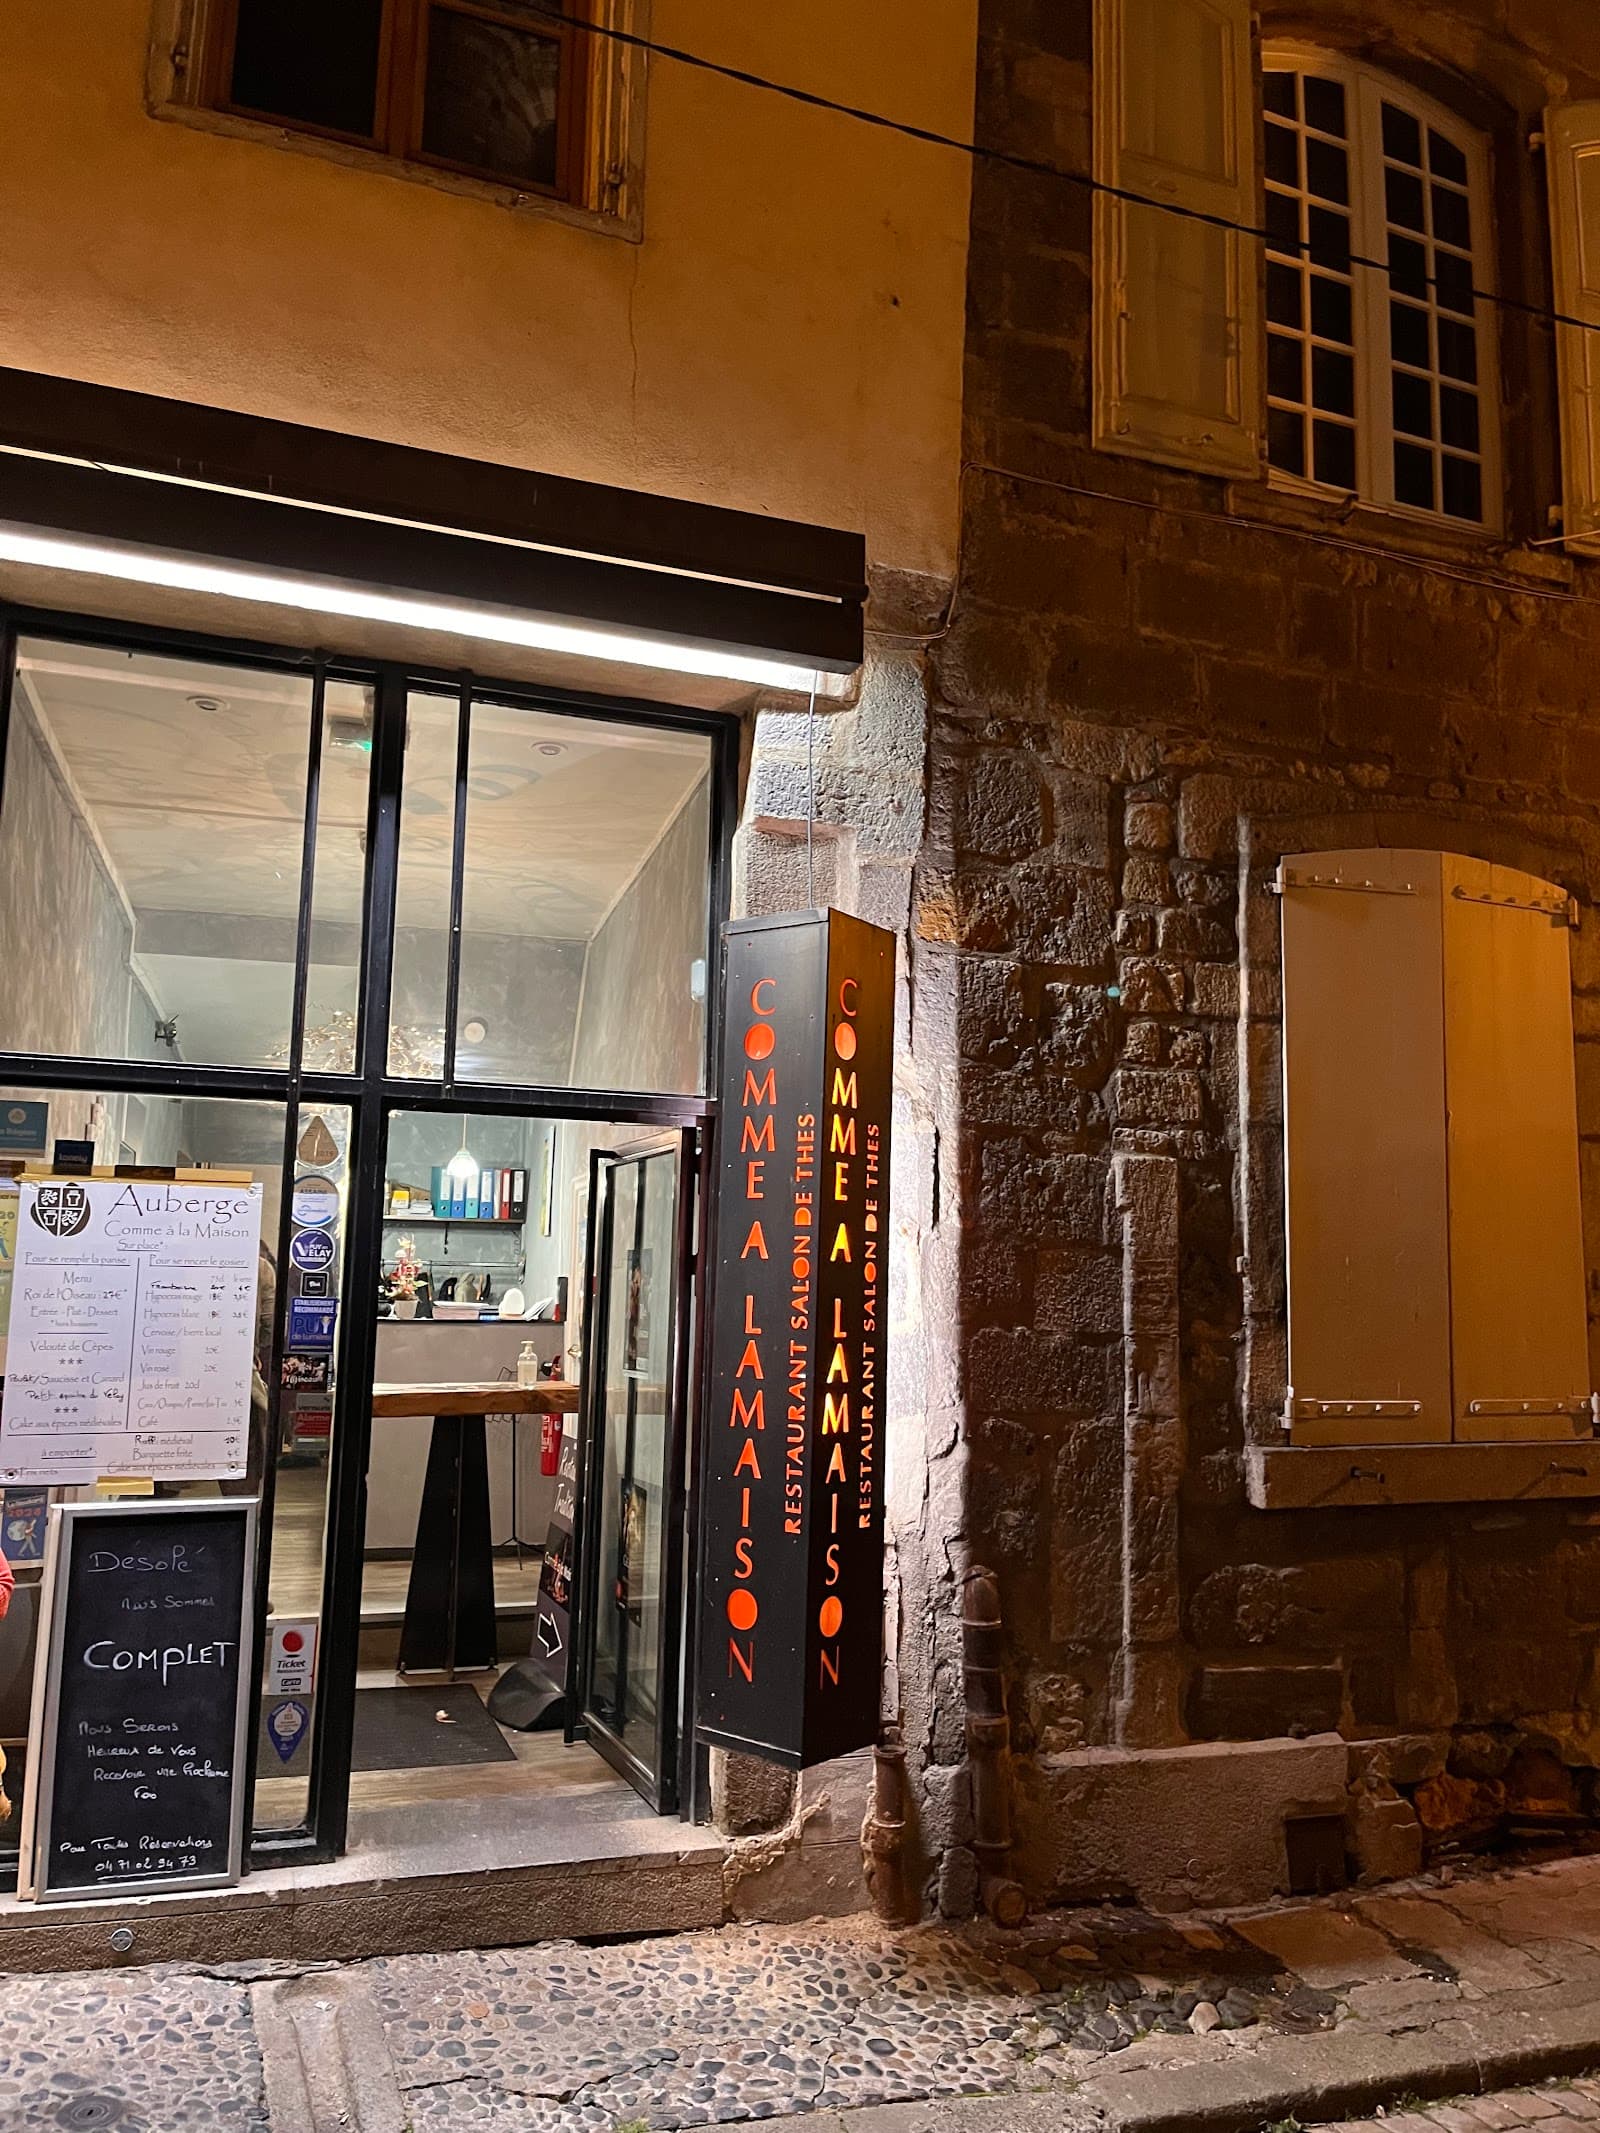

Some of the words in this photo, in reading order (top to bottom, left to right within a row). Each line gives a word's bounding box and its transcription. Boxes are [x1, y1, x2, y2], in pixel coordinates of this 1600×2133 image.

[740, 978, 778, 1199] COMME
[829, 978, 858, 1202] COMME
[795, 1113, 816, 1189] THES
[866, 1124, 880, 1190] THES
[108, 1184, 249, 1224] Auberge
[794, 1191, 814, 1226] DE
[865, 1199, 878, 1232] DE
[104, 1220, 162, 1237] Comme
[166, 1224, 175, 1236] à
[178, 1222, 191, 1236] la
[194, 1222, 249, 1238] Maison
[118, 1239, 136, 1249] Sur
[739, 1221, 769, 1260] A
[829, 1223, 852, 1263] A
[24, 1251, 48, 1264] Pour
[150, 1254, 171, 1266] Pour
[43, 1288, 55, 1300] de
[63, 1271, 92, 1285] Menu
[789, 1236, 813, 1330] SALON
[863, 1241, 877, 1332] SALON
[30, 1340, 66, 1353] Velouté
[68, 1340, 81, 1351] de
[141, 1344, 154, 1356] Vin
[155, 1347, 176, 1357] rouge
[140, 1362, 153, 1374] Vin
[136, 1379, 154, 1392] Jus
[154, 1379, 163, 1389] de
[784, 1339, 809, 1535] RESTAURANT
[858, 1341, 876, 1529] RESTAURANT
[83, 1640, 237, 1687] COMPLET
[277, 1659, 306, 1669] Ticket
[95, 1860, 113, 1873] 04
[118, 1859, 130, 1871] 71
[135, 1857, 153, 1870] 02
[179, 1855, 197, 1867] 73
